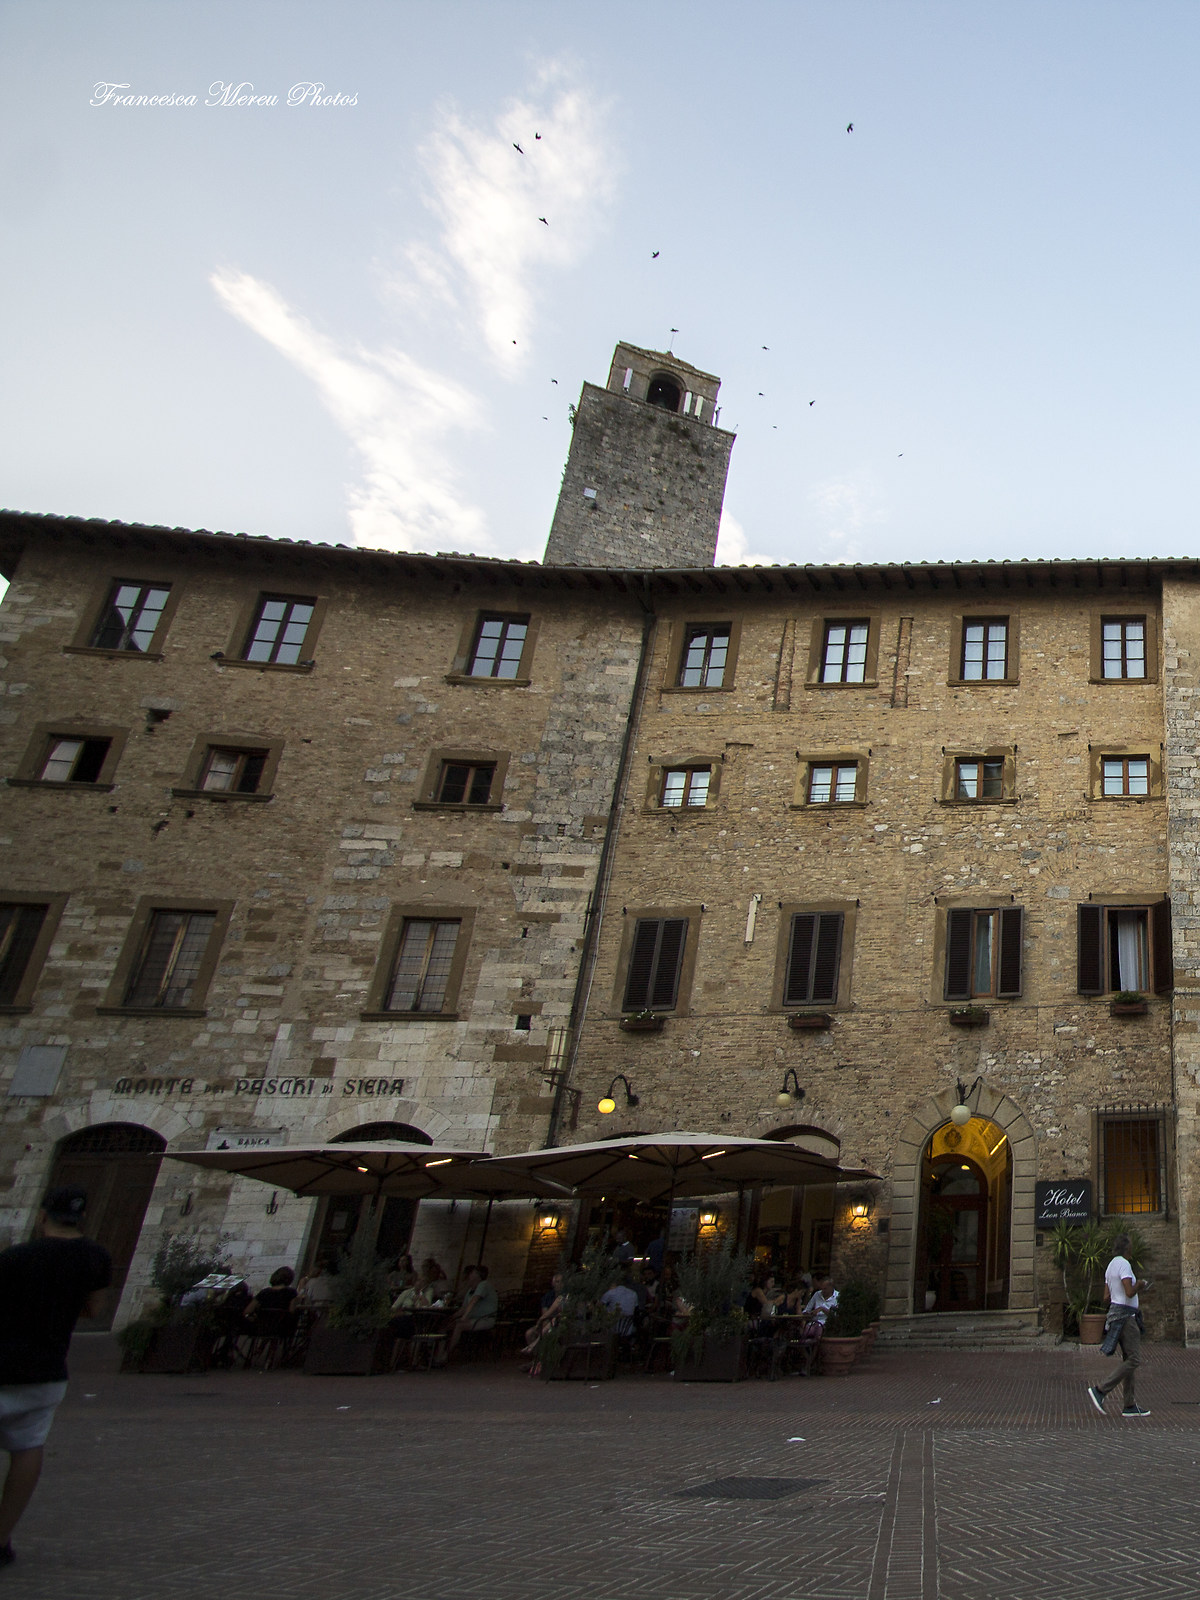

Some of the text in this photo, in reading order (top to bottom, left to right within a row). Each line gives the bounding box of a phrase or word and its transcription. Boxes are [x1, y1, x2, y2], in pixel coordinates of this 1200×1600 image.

[113, 1077, 195, 1095] MONTE
[342, 1077, 406, 1096] SIENA
[1043, 1188, 1085, 1207] Hotel
[1039, 1208, 1088, 1219] Leon Bianco
